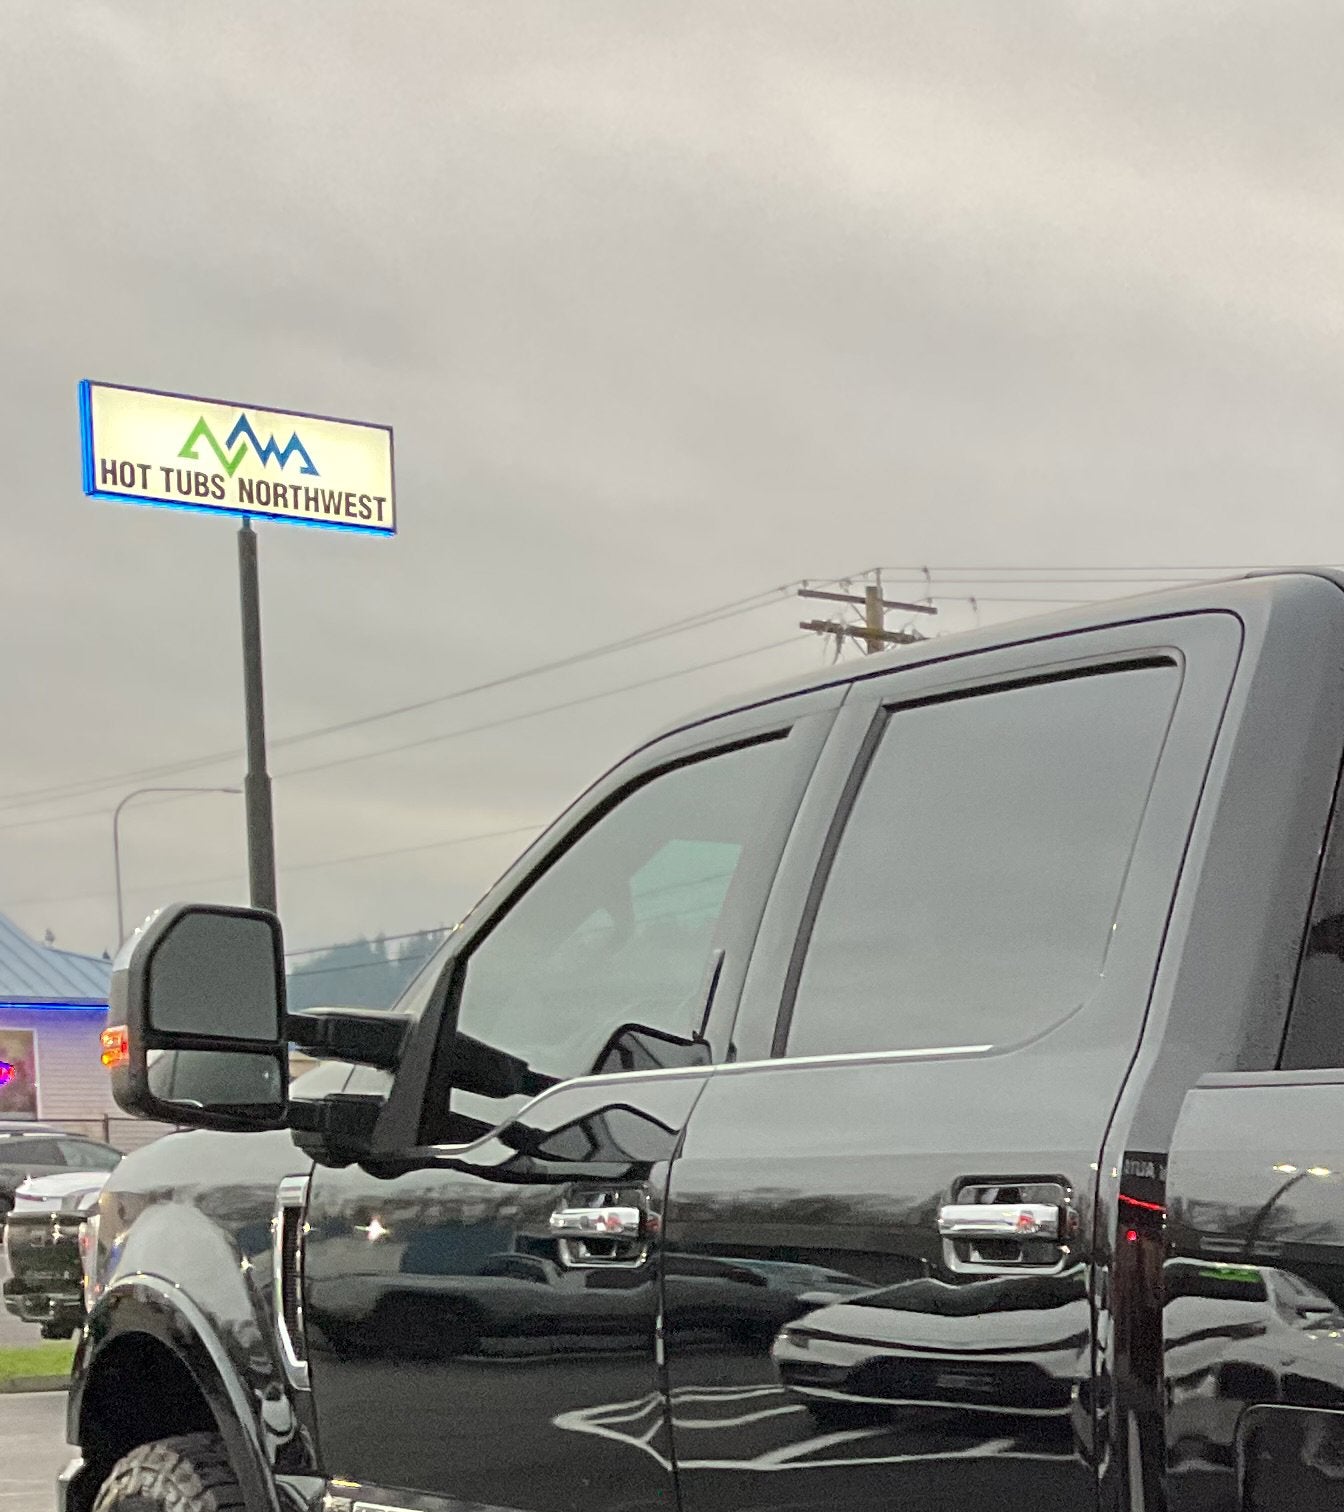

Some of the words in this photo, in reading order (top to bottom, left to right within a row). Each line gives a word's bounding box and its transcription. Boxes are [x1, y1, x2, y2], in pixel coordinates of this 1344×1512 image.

[101, 458, 152, 490] HOT
[160, 465, 226, 501] TUBS
[238, 476, 387, 522] NORTHWEST
